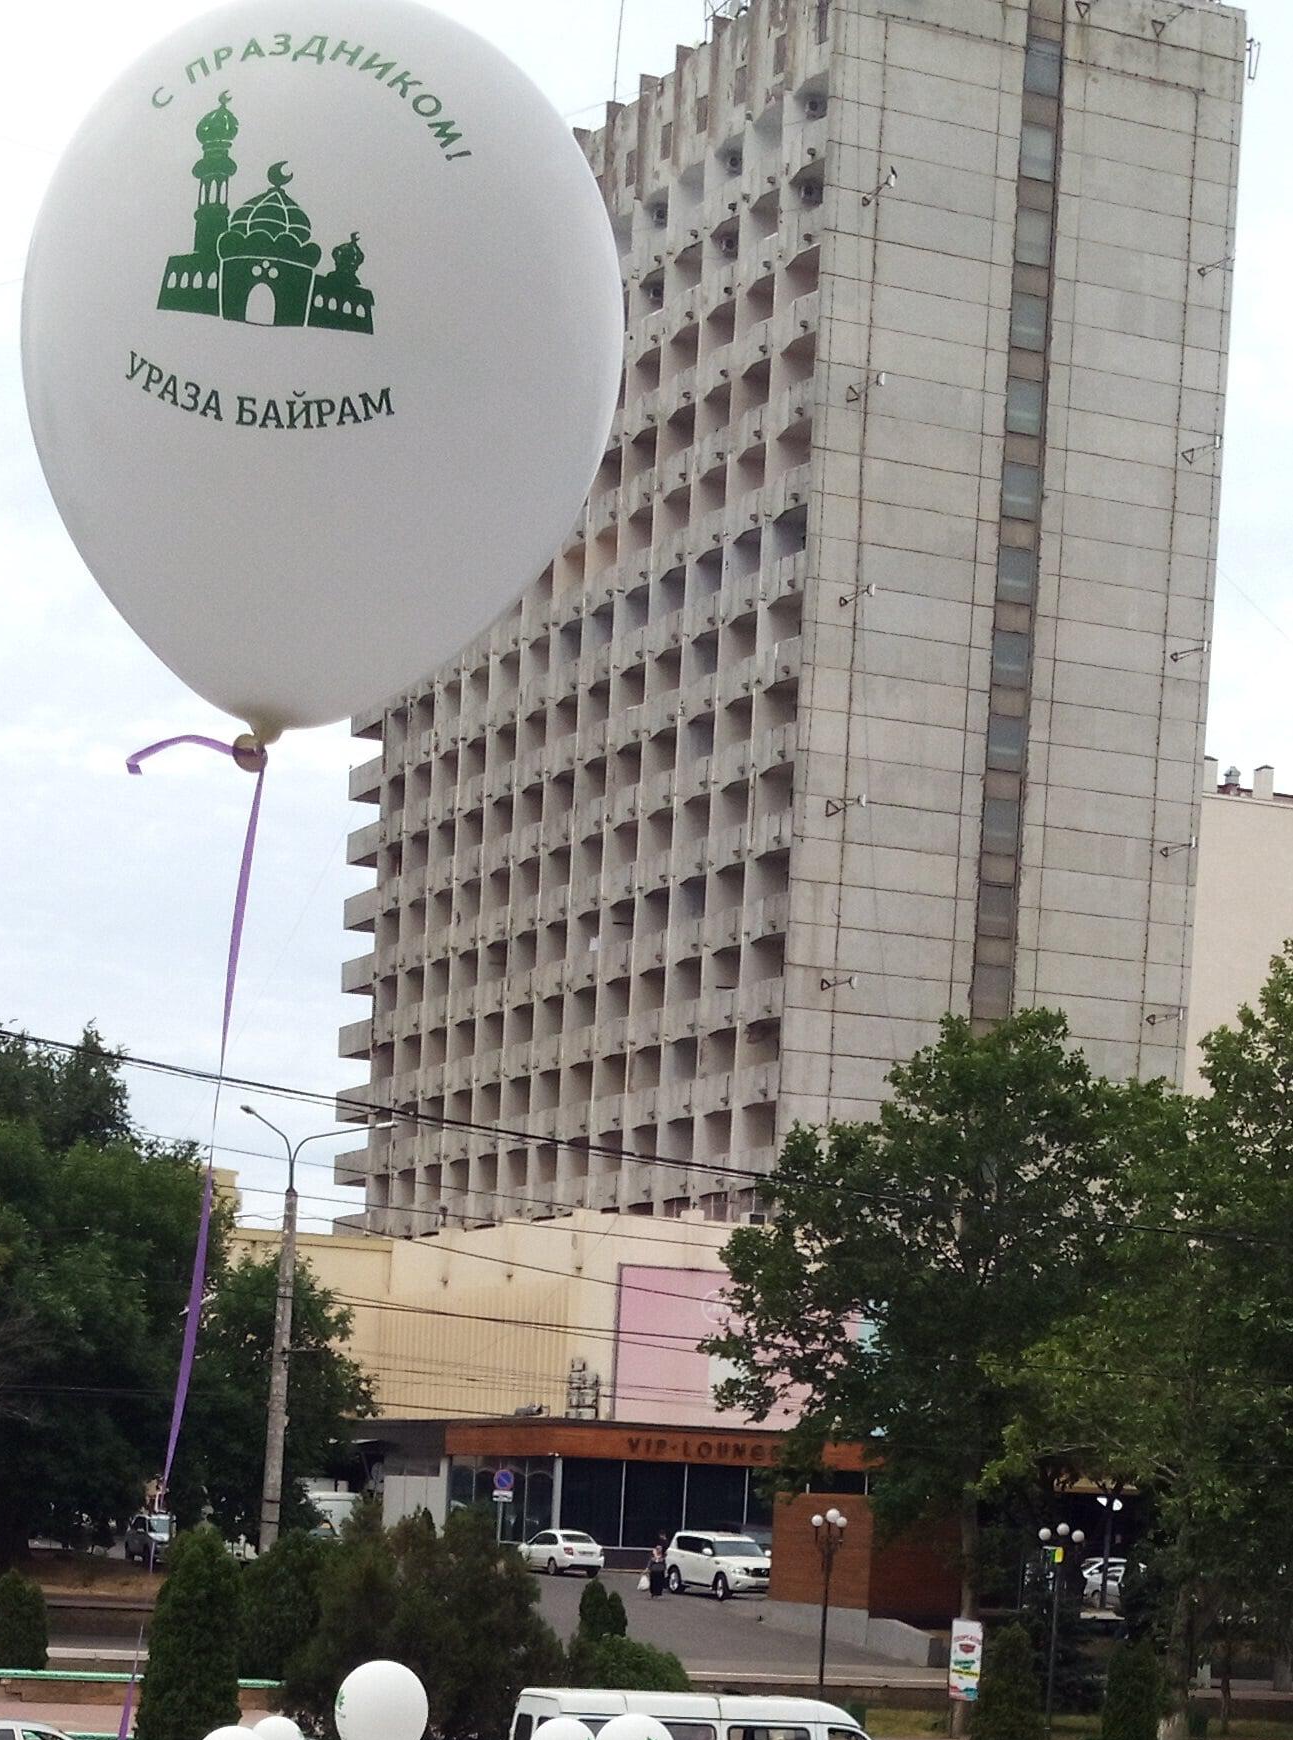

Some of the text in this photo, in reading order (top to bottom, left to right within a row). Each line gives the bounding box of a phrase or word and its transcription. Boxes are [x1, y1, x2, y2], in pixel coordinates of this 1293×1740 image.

[151, 33, 472, 162] С ПРАЗДНИКОМ!
[124, 351, 396, 430] УРАЗА БАЙРАМ
